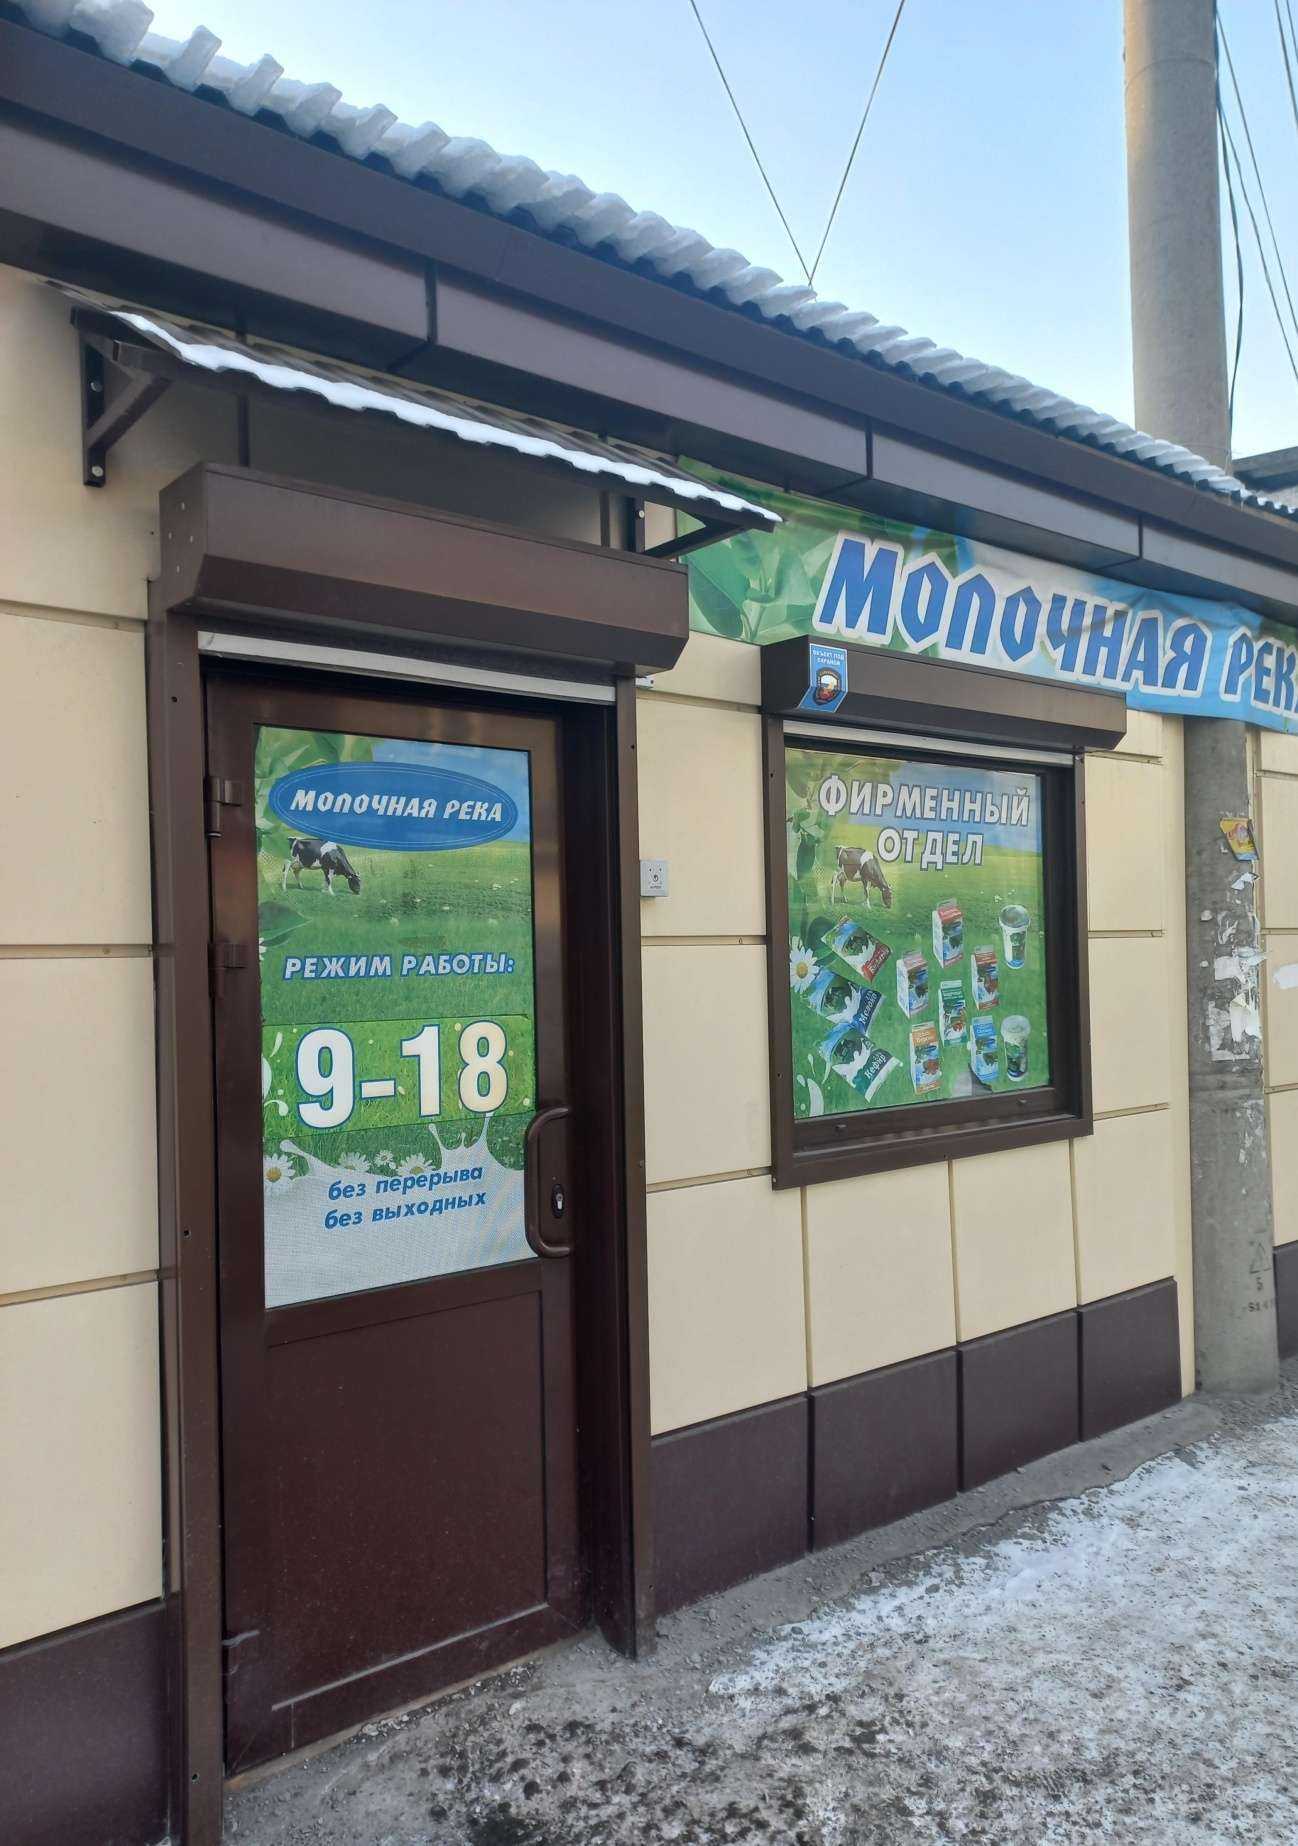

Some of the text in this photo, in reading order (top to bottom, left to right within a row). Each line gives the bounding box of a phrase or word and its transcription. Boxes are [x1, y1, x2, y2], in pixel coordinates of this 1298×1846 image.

[817, 537, 1298, 715] МОЛОЧНАЯ РЕК
[290, 789, 503, 822] МОЛОЧНАЯ РЕКА
[818, 775, 1030, 827] ФИРМЕННЫЙ
[877, 827, 984, 871] ОТДЕЛ
[284, 953, 515, 980] РЕЖИМ РАБОТЫ:
[296, 1020, 508, 1129] 9-18
[328, 1166, 483, 1201] без перерыва
[324, 1191, 487, 1230] без выходных
